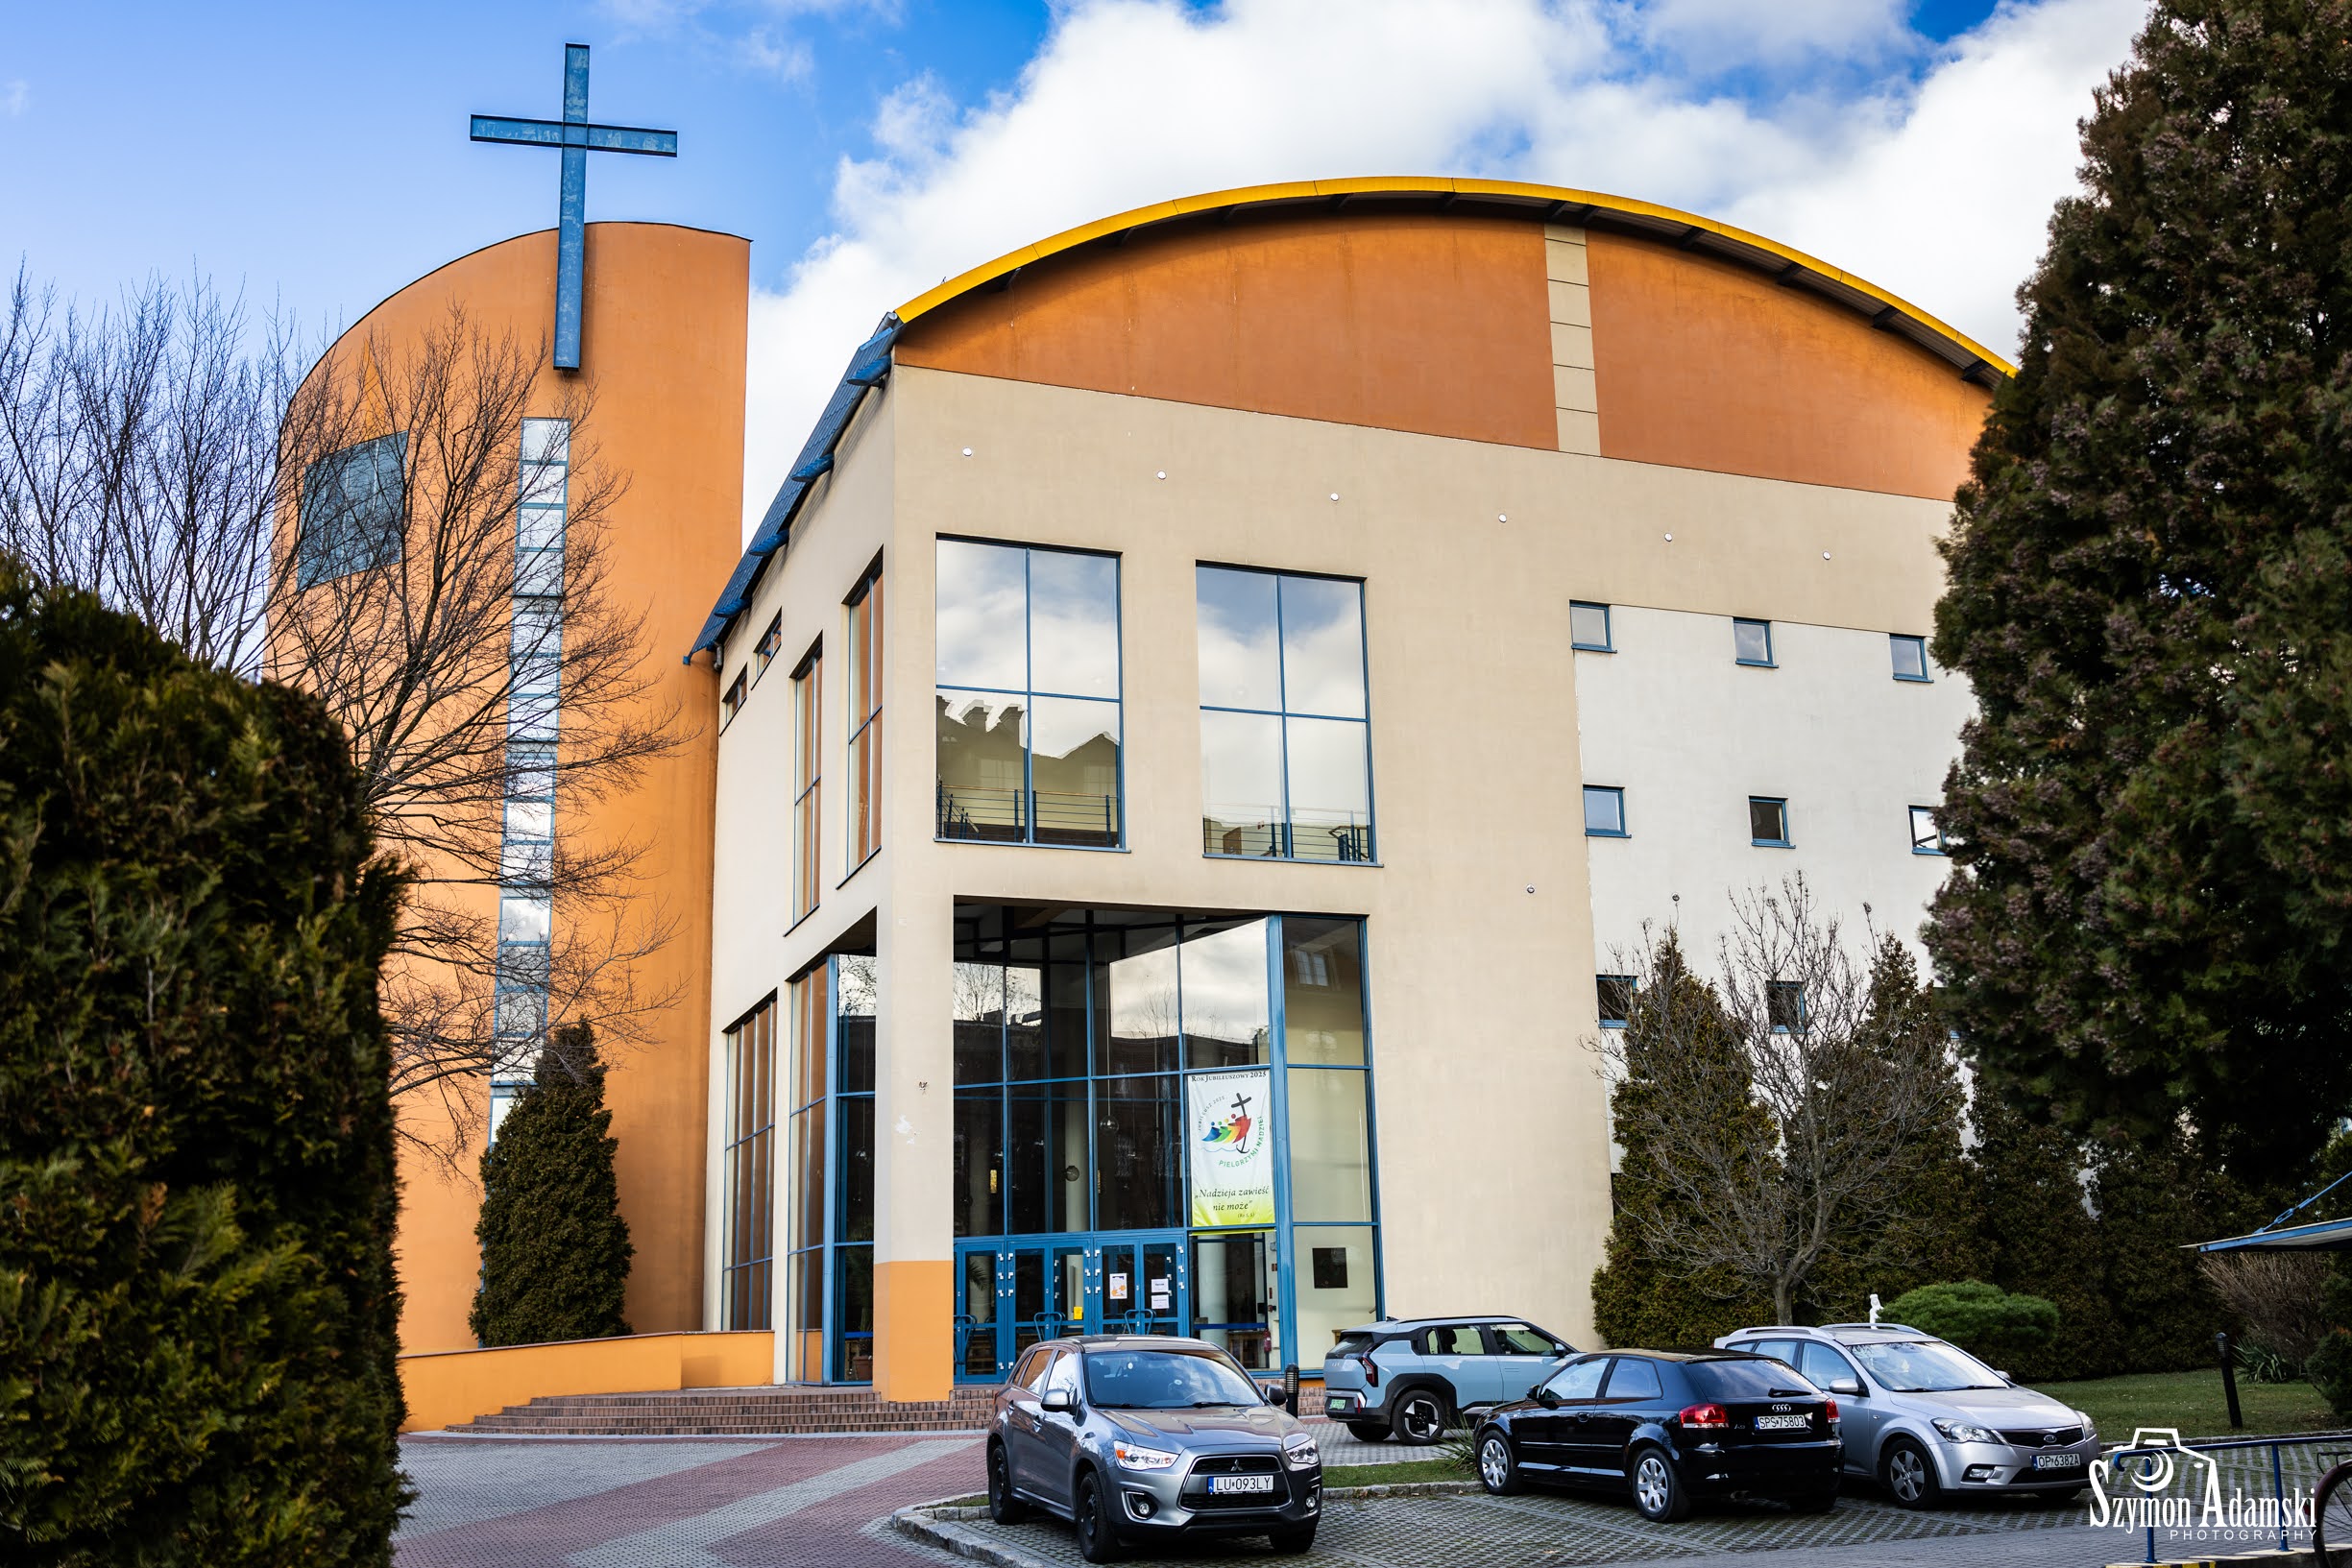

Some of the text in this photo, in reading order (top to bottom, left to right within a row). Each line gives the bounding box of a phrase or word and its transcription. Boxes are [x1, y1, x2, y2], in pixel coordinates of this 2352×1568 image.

[1213, 1096, 1225, 1104] 2025
[1219, 1116, 1265, 1168] PIELGRZYMI NADZIEI
[1238, 1185, 1270, 1196] zawieść
[1758, 1415, 1805, 1429] SPS 75803
[2038, 1455, 2079, 1467] OP 6382A
[1216, 1477, 1271, 1490] LU 093LY
